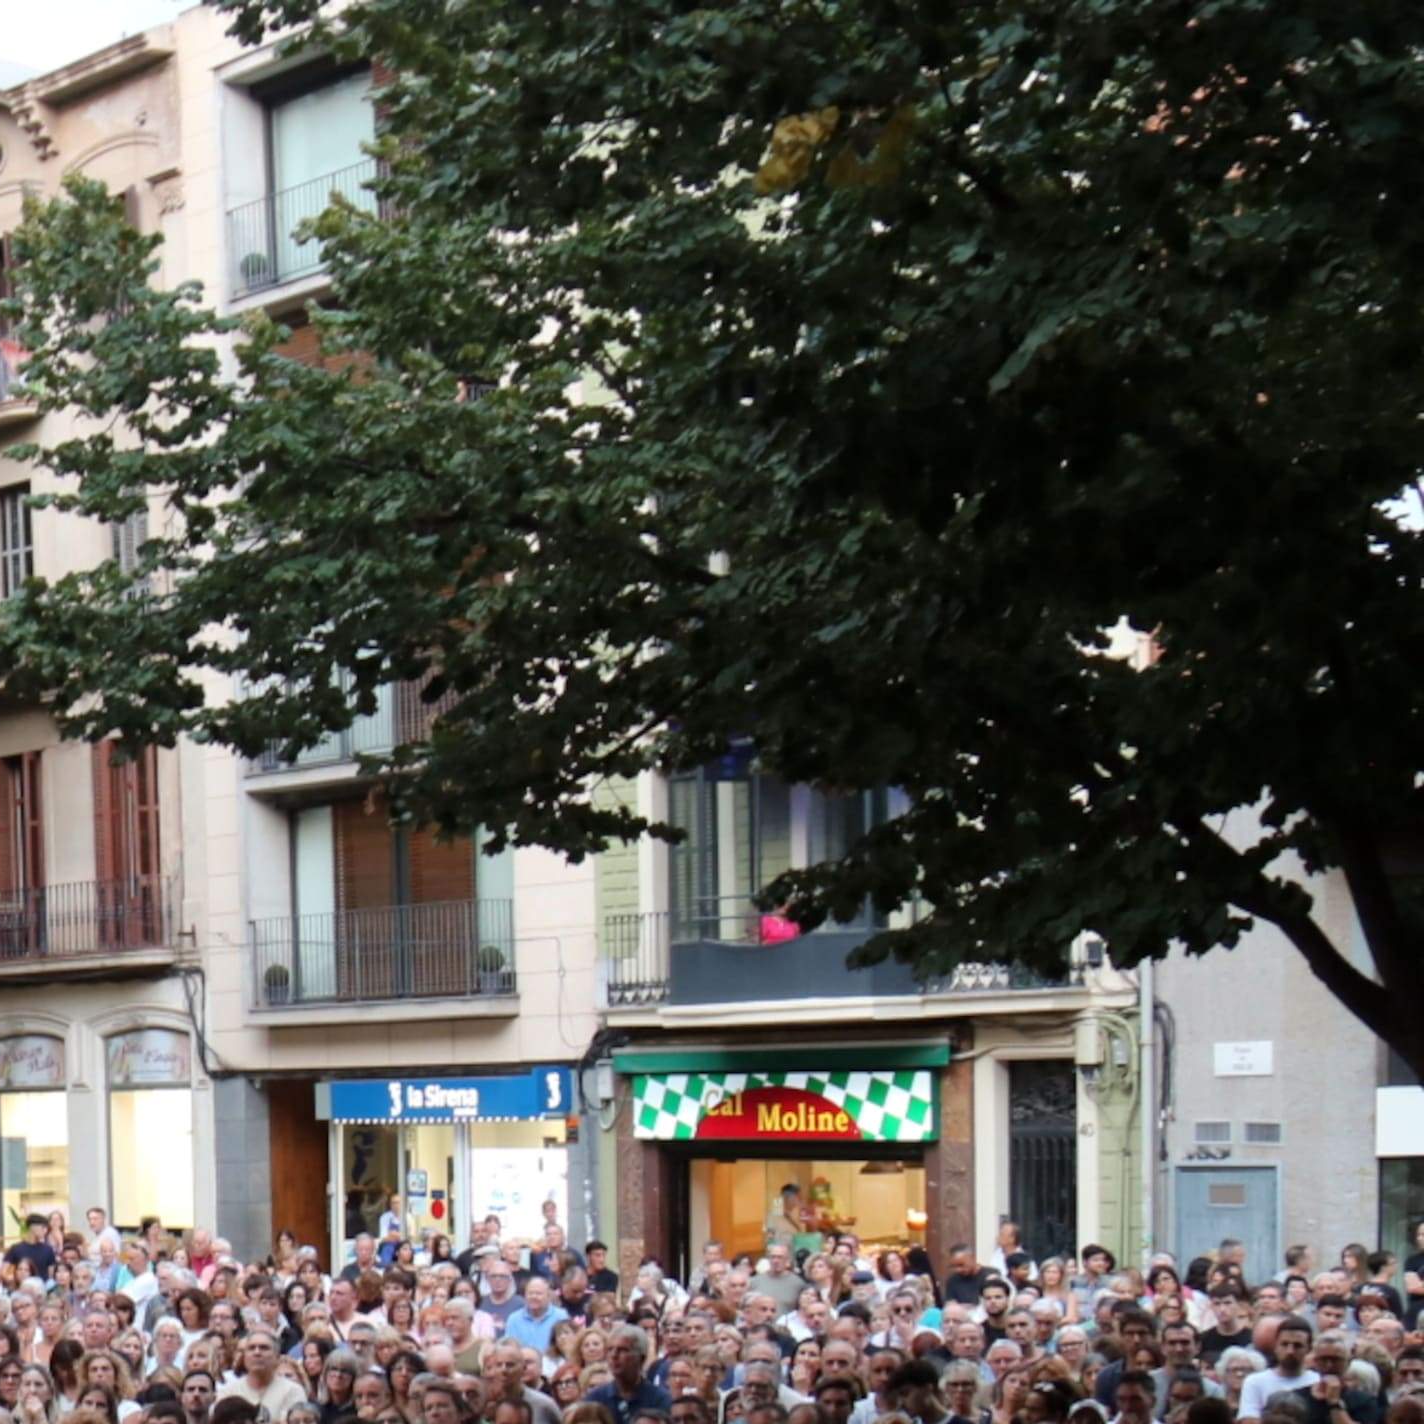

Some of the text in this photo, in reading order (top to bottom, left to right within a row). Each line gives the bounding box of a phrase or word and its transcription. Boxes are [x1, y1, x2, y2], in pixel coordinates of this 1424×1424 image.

[406, 1083, 479, 1109] la Sirena
[705, 1087, 744, 1116] Cal
[757, 1102, 849, 1133] Moline
